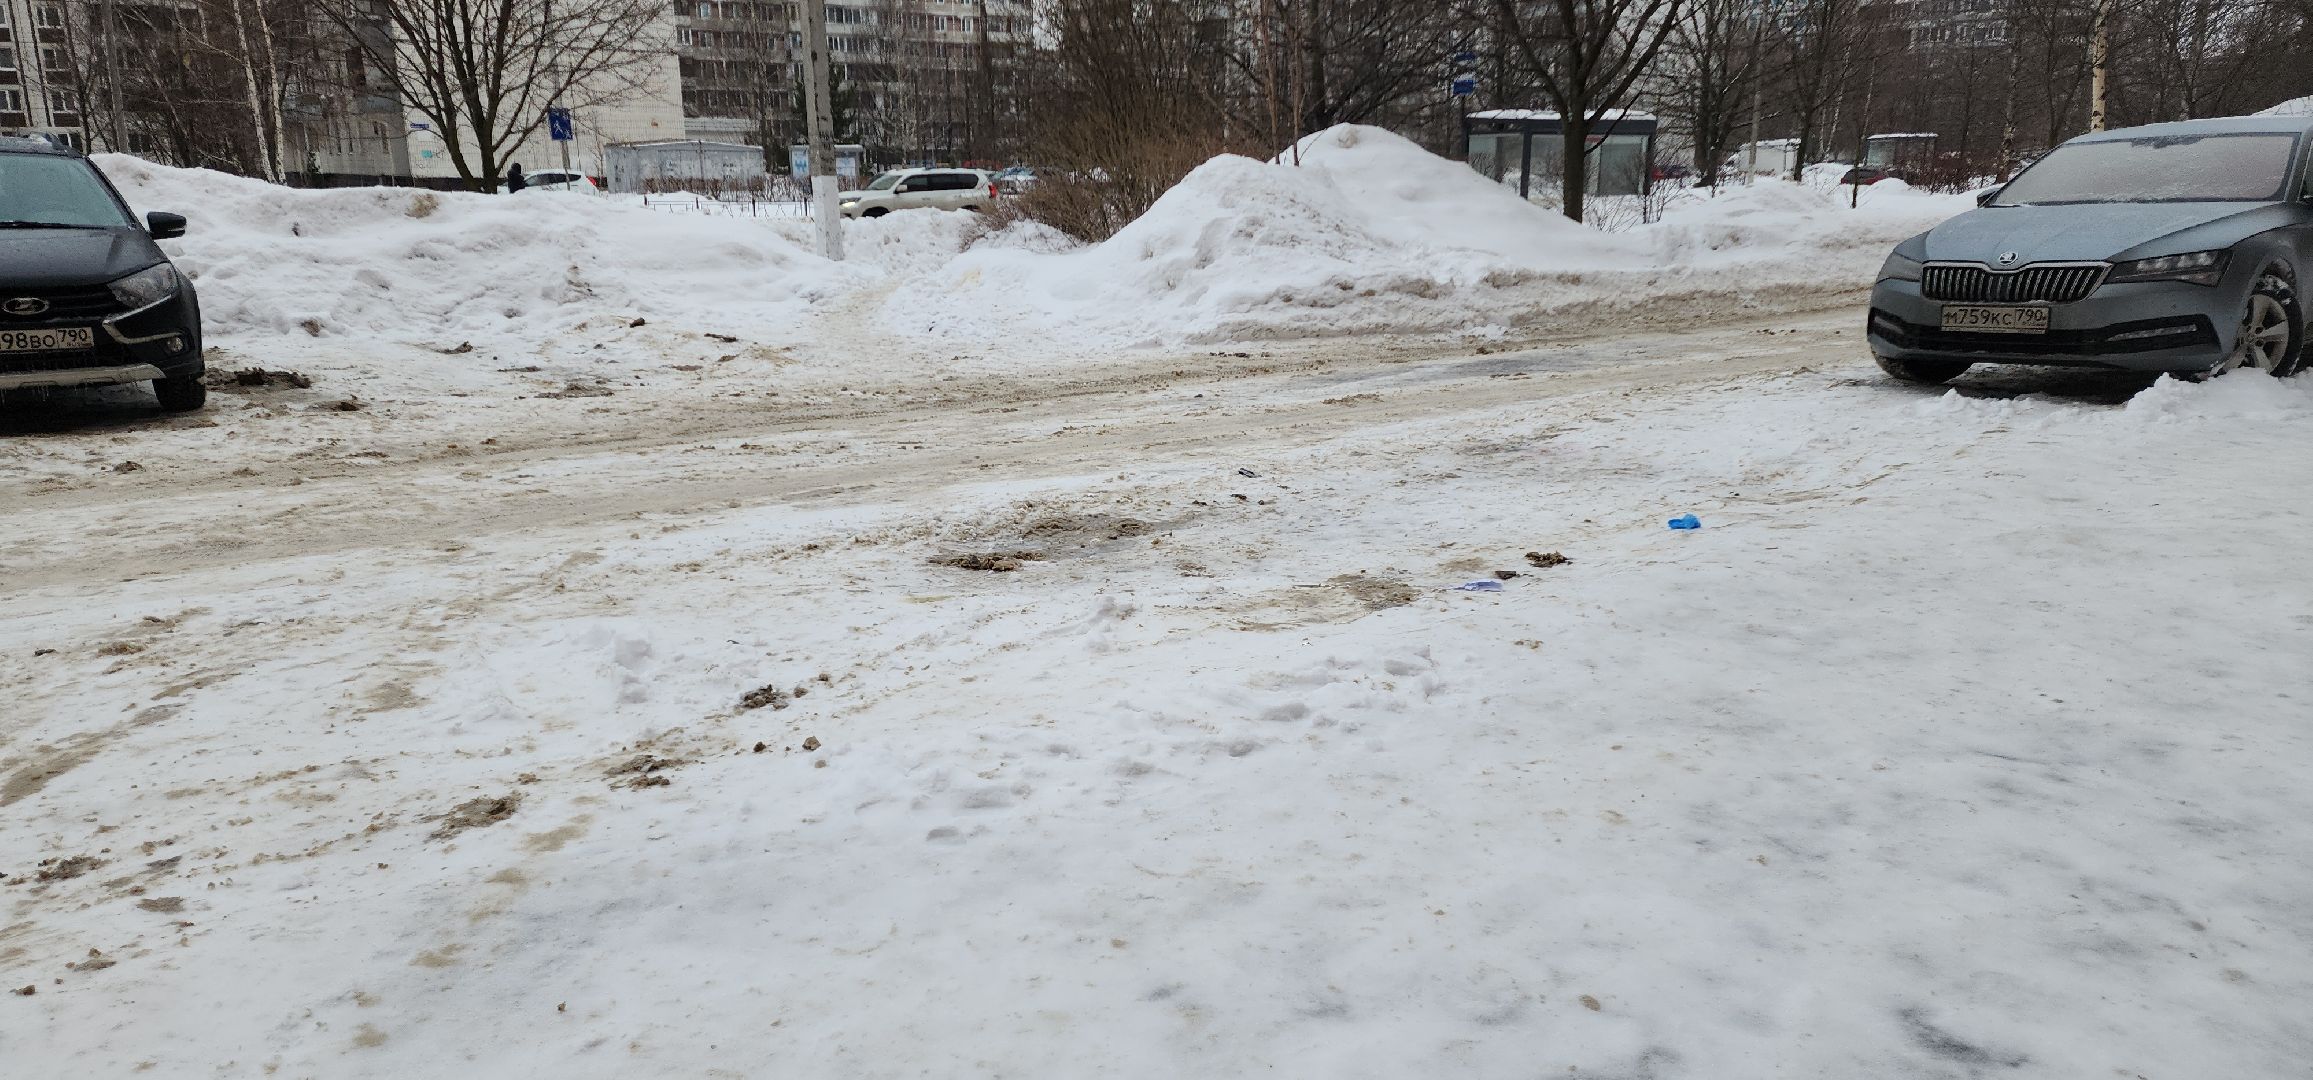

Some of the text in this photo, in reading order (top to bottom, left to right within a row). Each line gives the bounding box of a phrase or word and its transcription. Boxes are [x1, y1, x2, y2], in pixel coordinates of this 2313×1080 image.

[2016, 308, 2043, 322] 790
[0, 329, 88, 349] 98ВО 790
